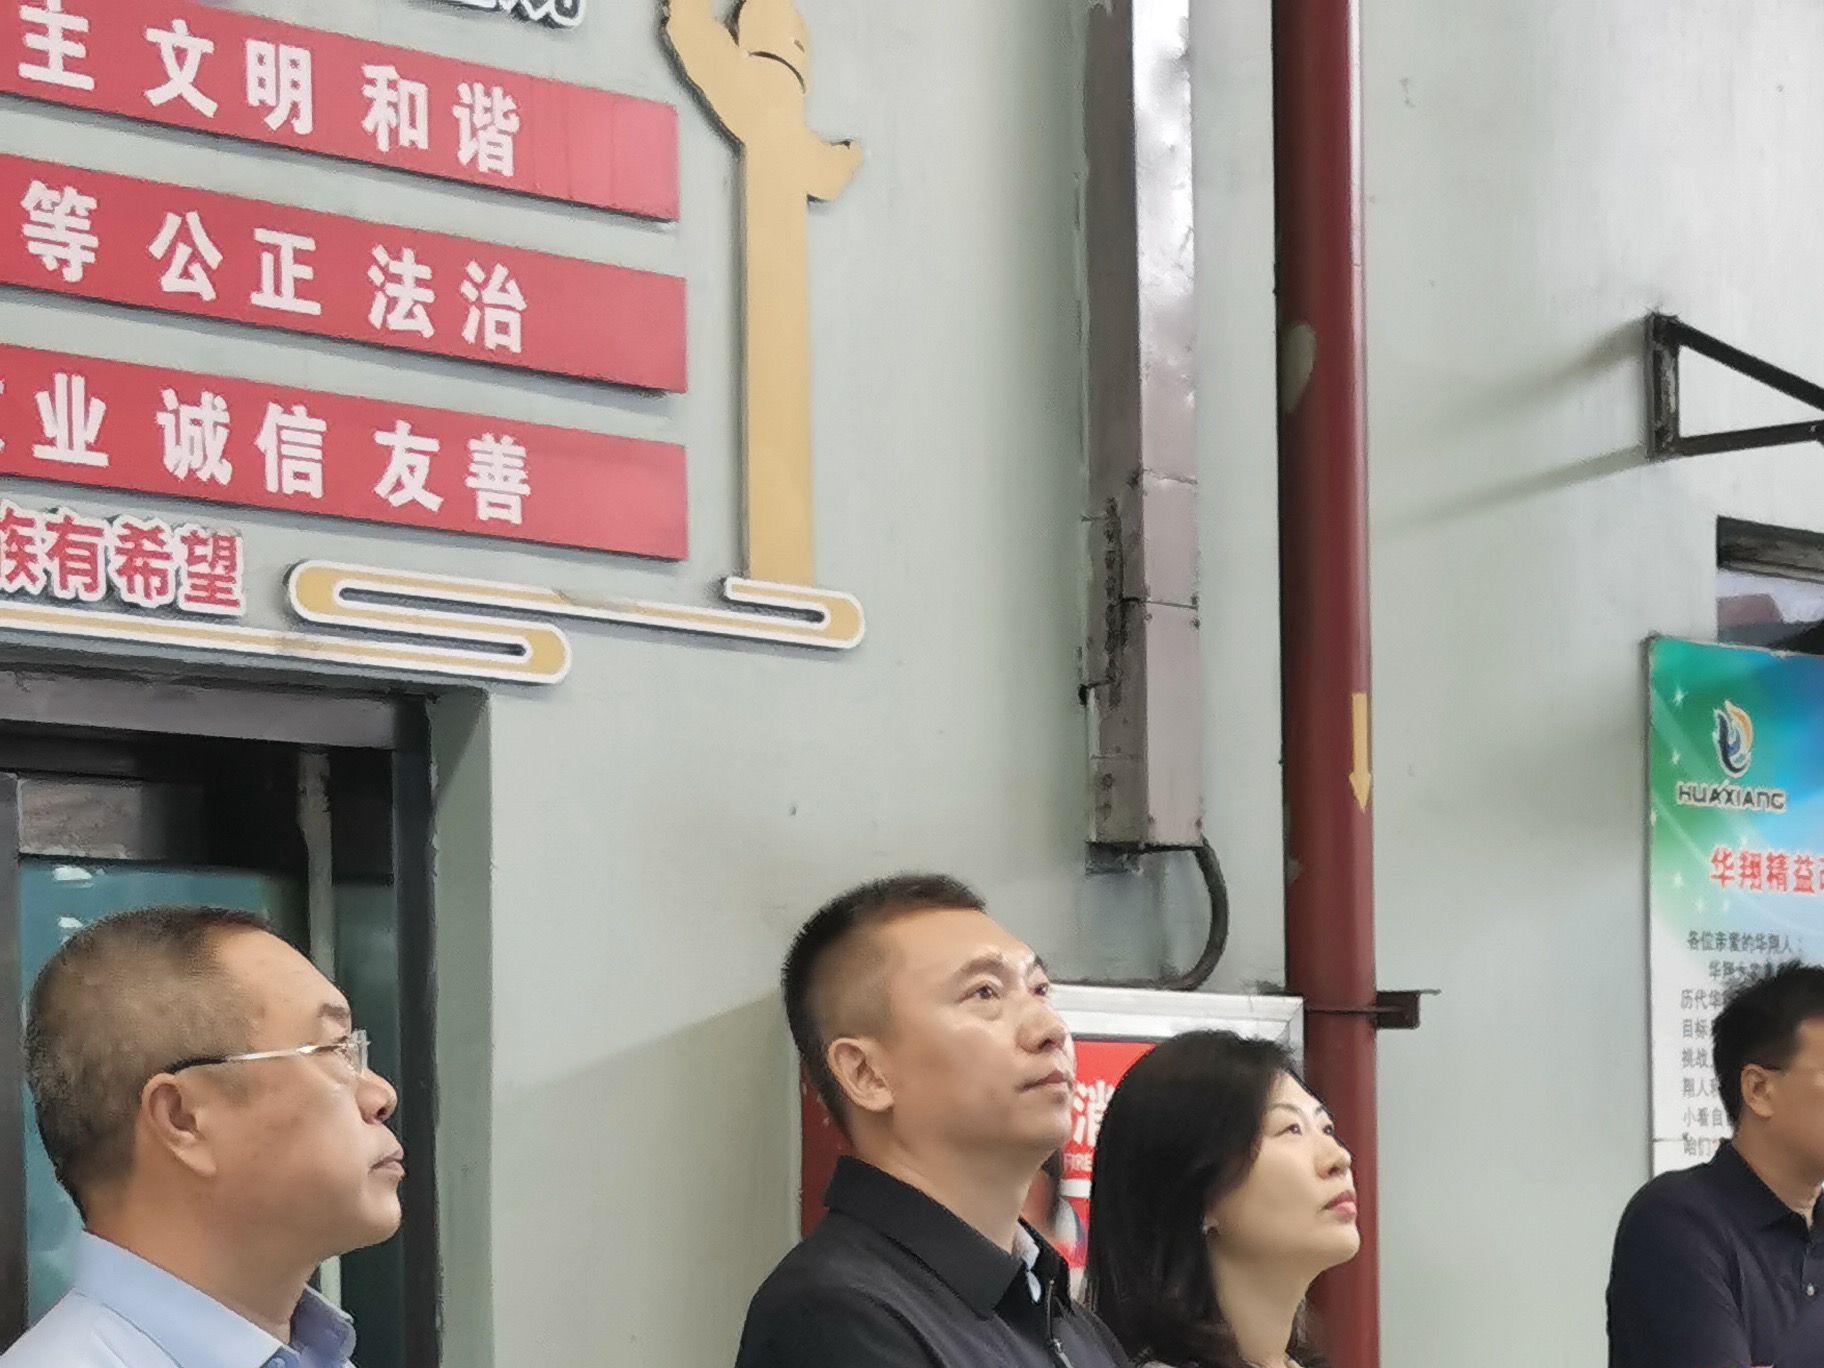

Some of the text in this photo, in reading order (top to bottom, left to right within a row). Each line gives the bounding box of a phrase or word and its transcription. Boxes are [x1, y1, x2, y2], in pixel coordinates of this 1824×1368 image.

[143, 19, 313, 134] 文明
[361, 65, 521, 176] 和谐
[21, 181, 527, 353] 等 公正 法治
[0, 373, 532, 525] 业 诚信 友善
[1677, 782, 1785, 810] HUAXIANG
